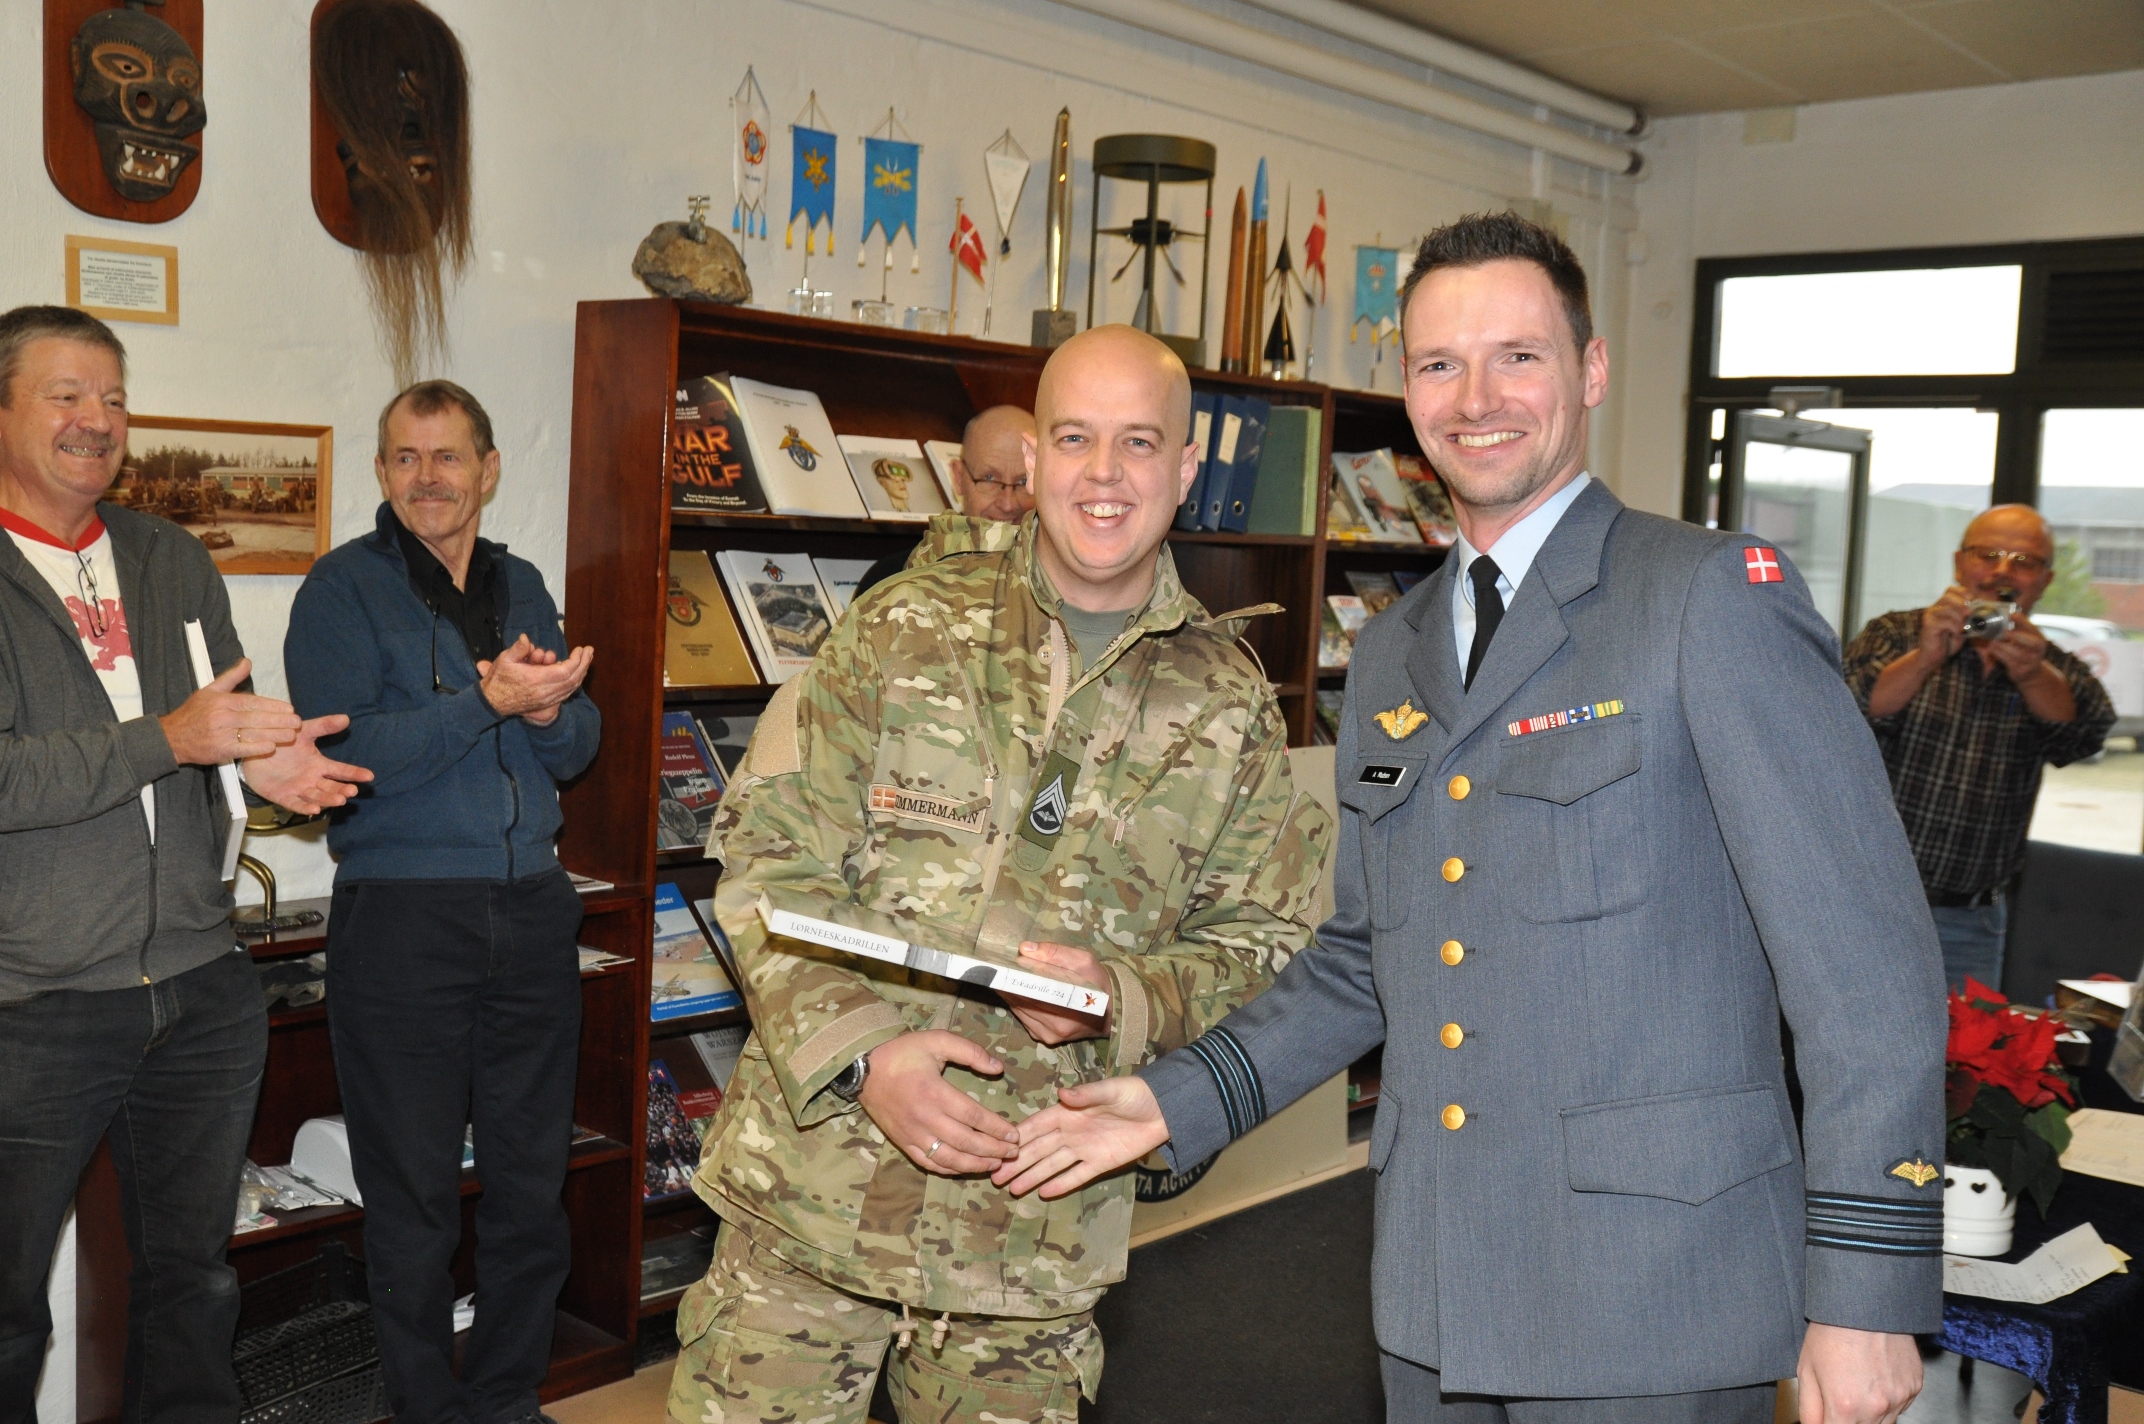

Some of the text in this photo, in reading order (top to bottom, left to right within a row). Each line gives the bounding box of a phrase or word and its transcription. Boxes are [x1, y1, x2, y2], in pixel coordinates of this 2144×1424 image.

[691, 453, 722, 466] THE
[672, 463, 742, 488] GULF
[659, 767, 703, 778] riegszeppelin
[790, 922, 890, 954] LØRNEESKADRILLEN
[1011, 978, 1065, 999] Eskadrille 724
